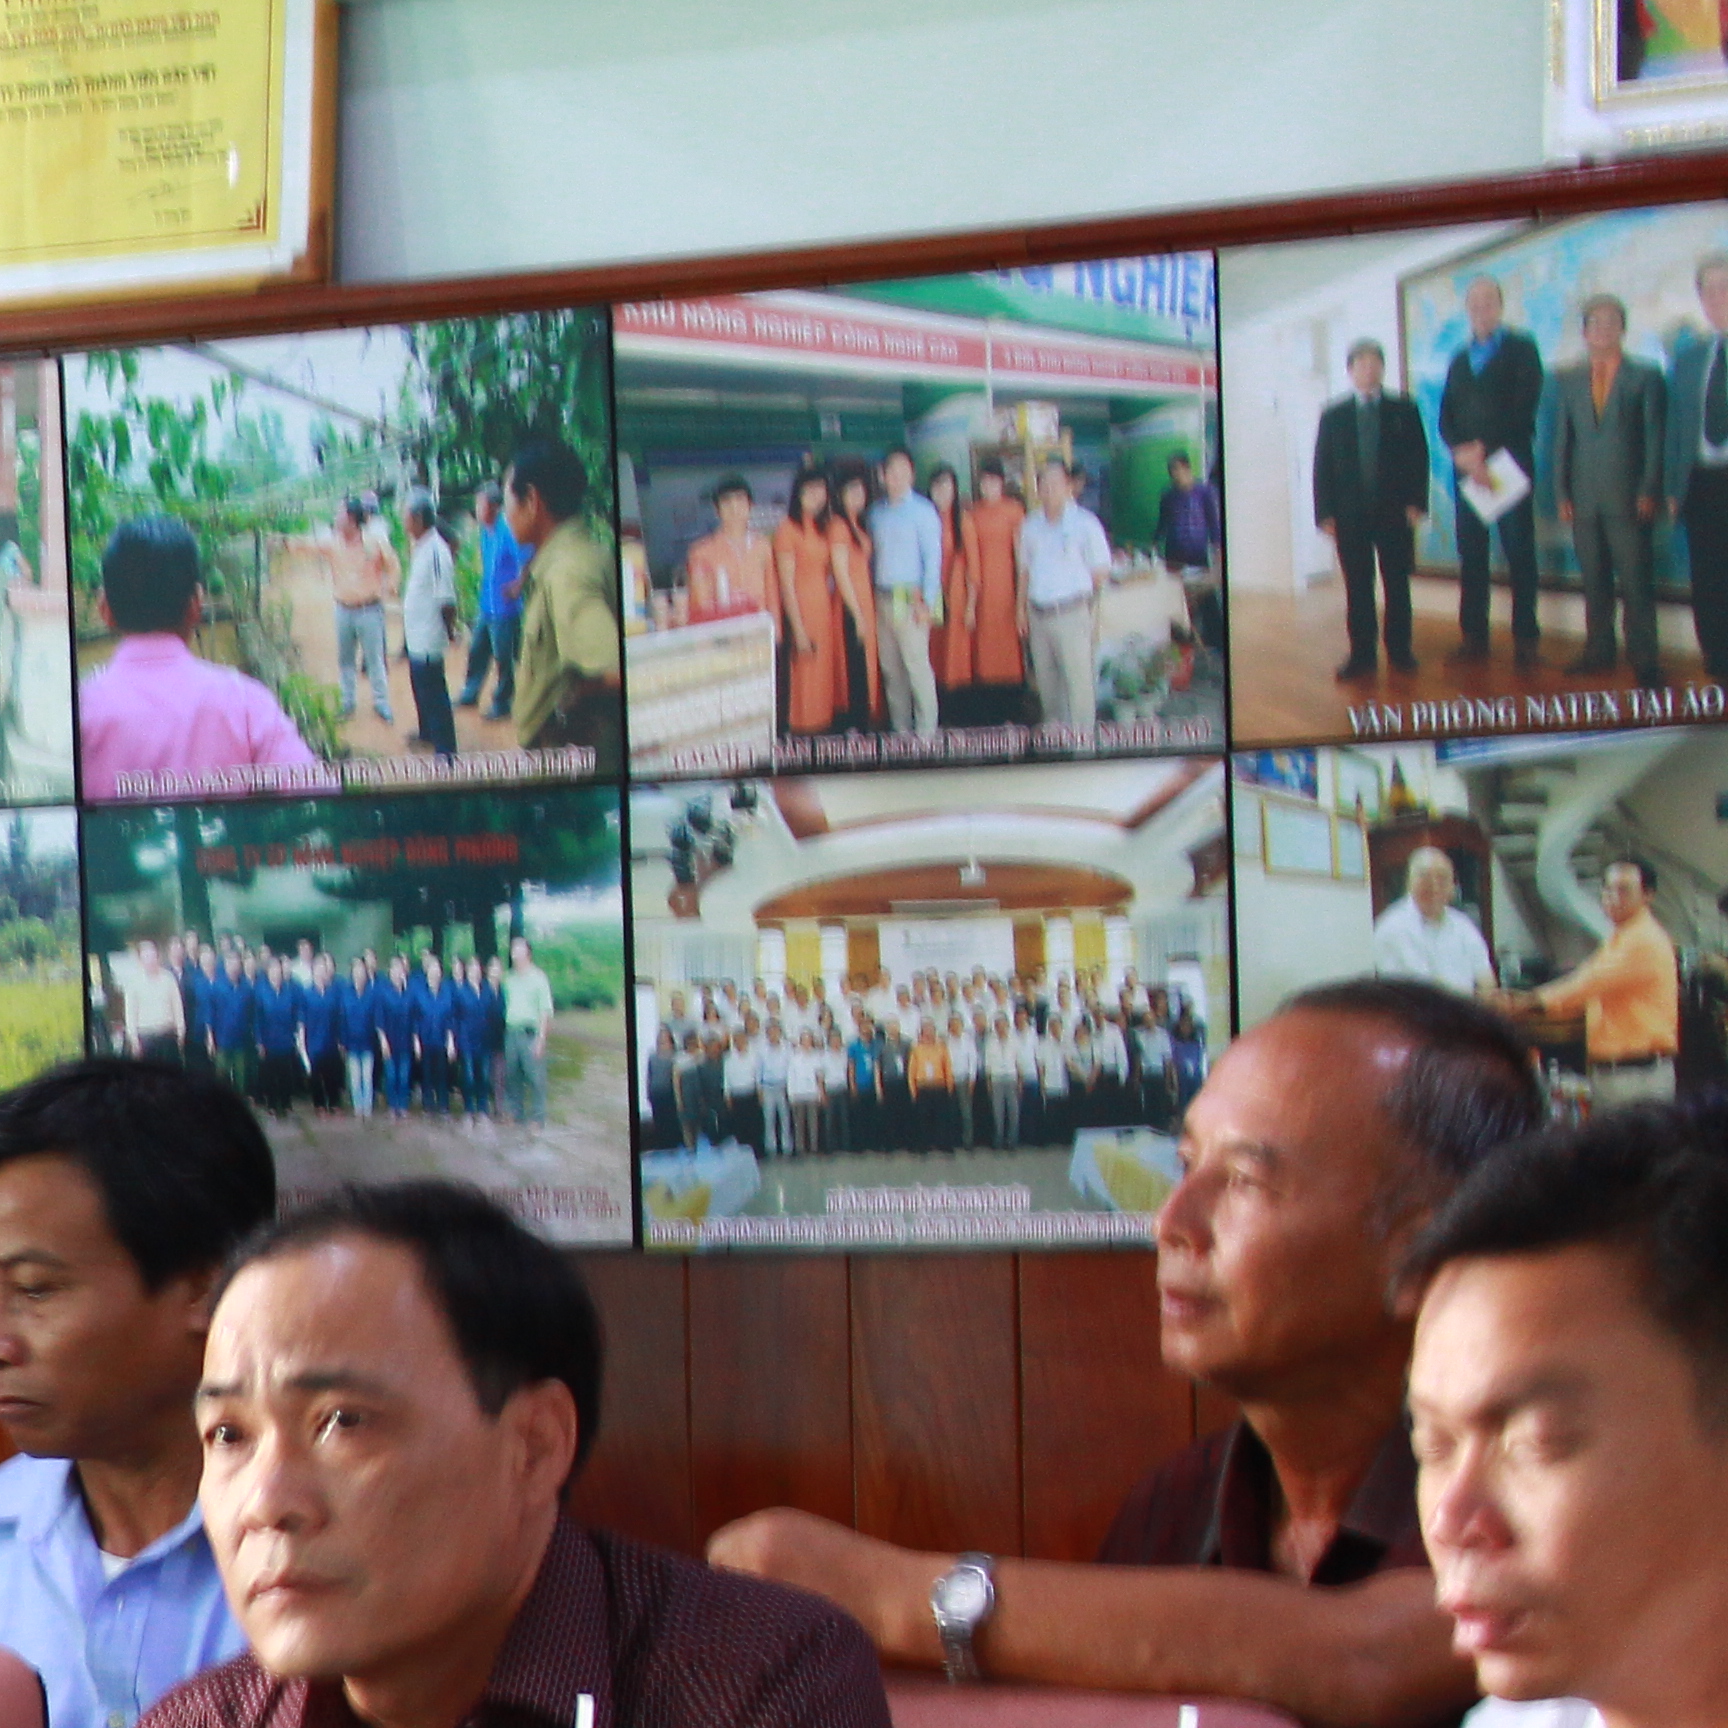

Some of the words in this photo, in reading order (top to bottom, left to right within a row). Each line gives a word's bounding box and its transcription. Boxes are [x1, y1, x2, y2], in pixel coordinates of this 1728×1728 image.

[1346, 700, 1403, 738] VĂN
[1411, 693, 1518, 734] PHÒNG
[1525, 689, 1621, 729] NATEX
[1626, 685, 1674, 727] TẠI
